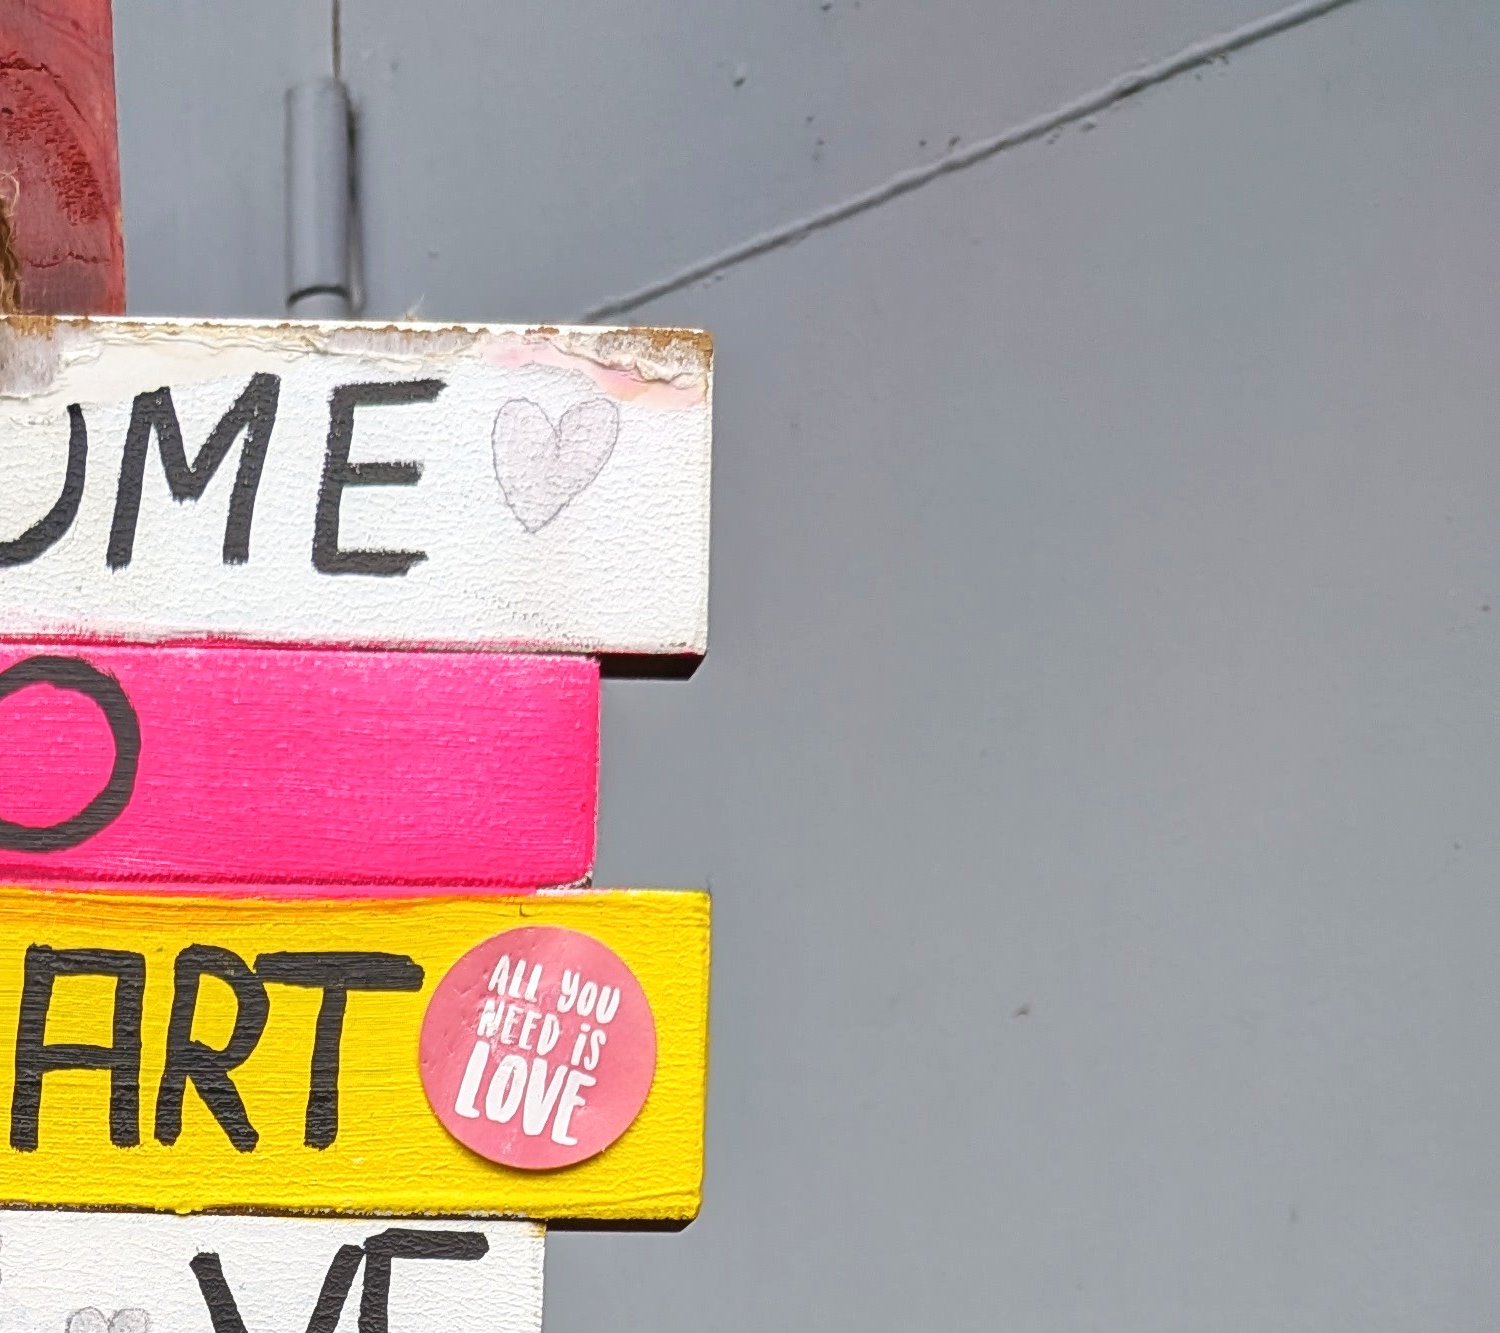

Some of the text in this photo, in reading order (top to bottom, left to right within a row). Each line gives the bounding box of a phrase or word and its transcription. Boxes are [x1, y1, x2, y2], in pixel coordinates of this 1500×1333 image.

[477, 999, 560, 1056] NEED
[487, 955, 620, 1024] ALL YOU
[9, 941, 424, 1152] ART
[454, 1041, 596, 1145] LOVE
